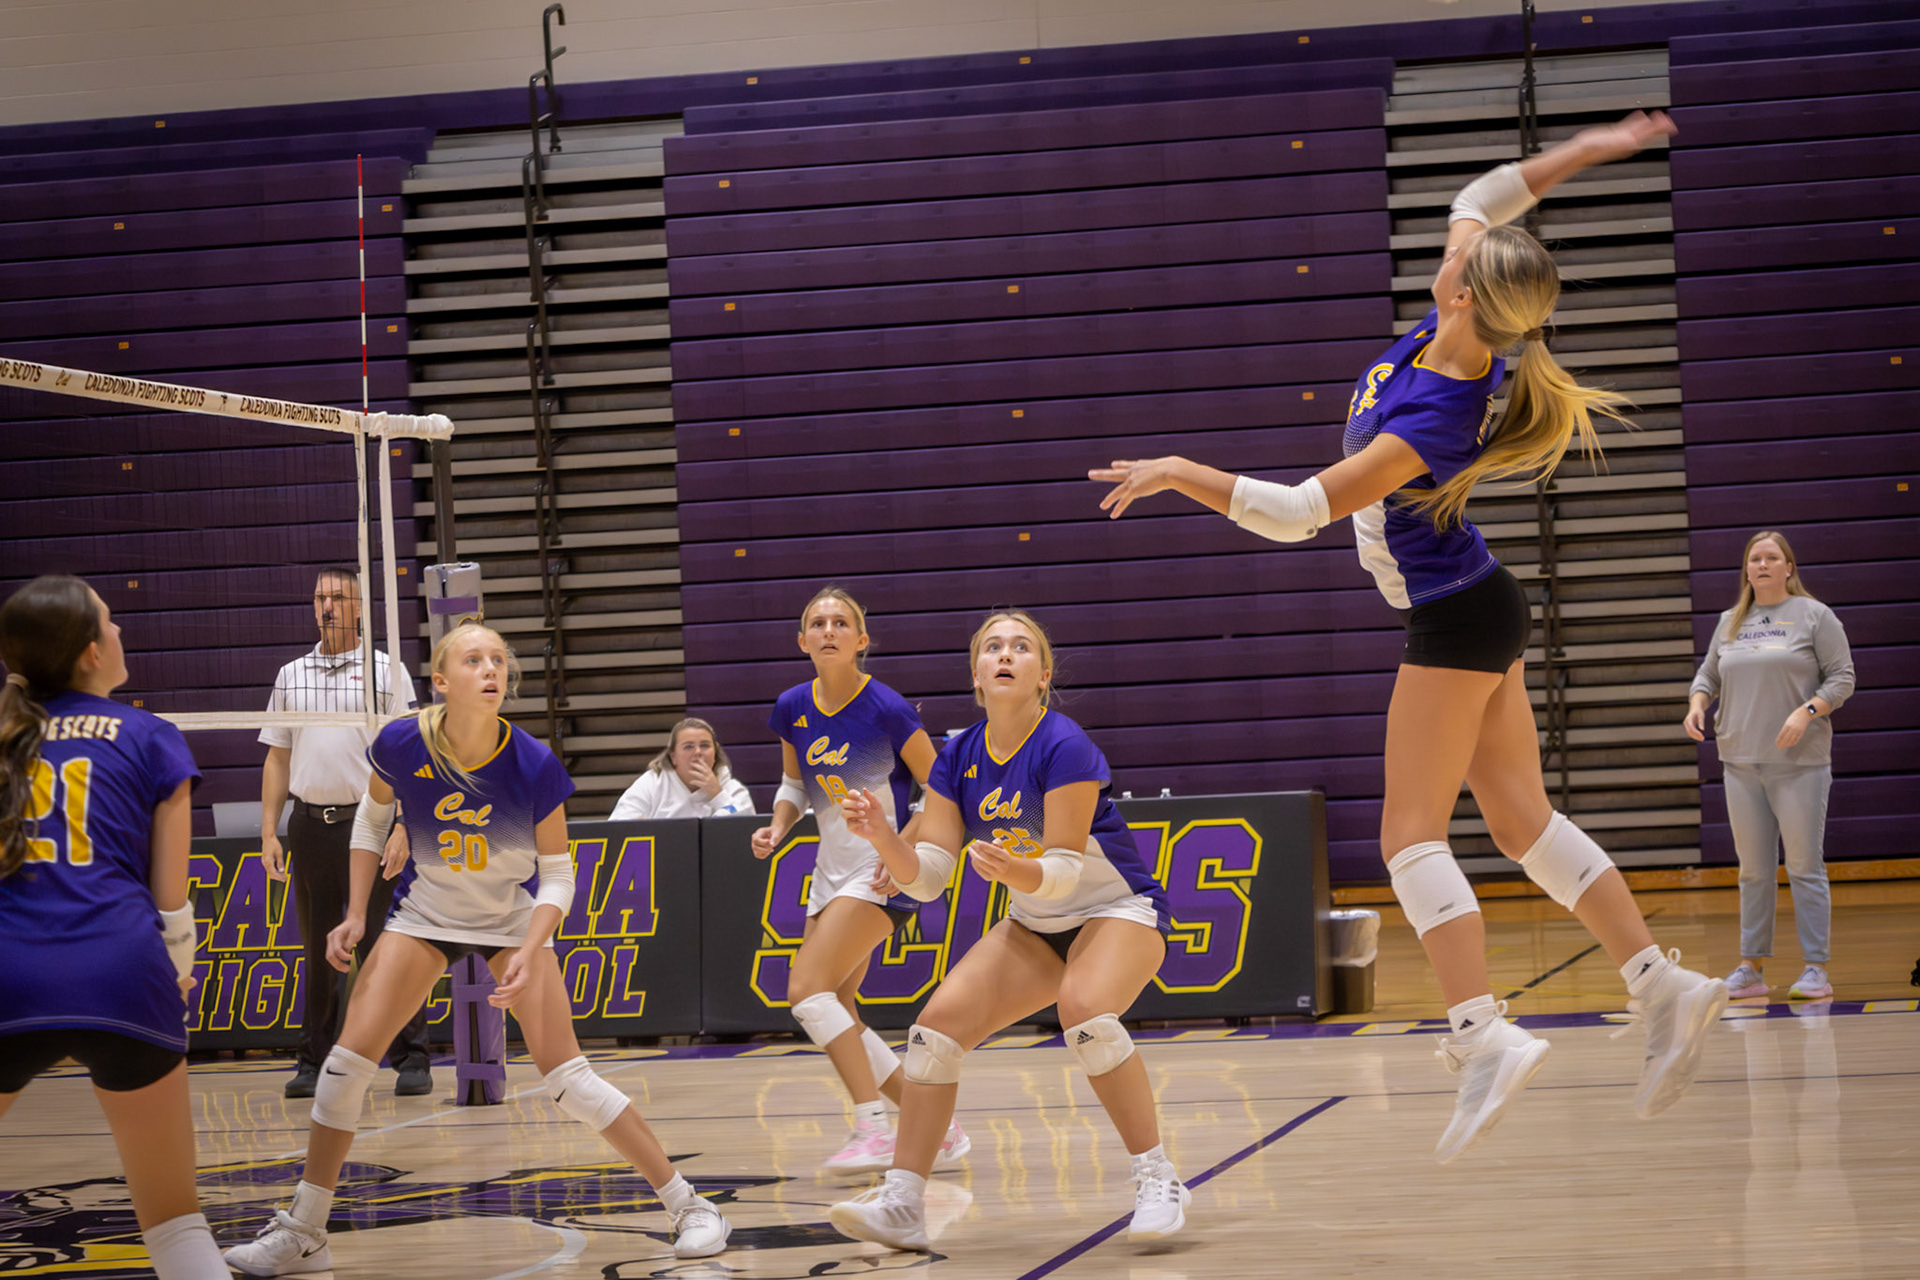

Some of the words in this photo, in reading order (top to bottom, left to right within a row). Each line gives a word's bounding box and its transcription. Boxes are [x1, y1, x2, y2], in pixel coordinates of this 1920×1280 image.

[10, 361, 43, 383] SCOTS
[84, 373, 136, 397] CALEDONIA
[135, 382, 179, 404] FIGHTING
[177, 388, 206, 407] SCOTS
[240, 397, 282, 417] CALEDONIA
[282, 404, 318, 422] FIGHTING
[319, 408, 341, 425] SCOTS
[1736, 630, 1786, 641] CALEDONIA
[59, 715, 122, 742] SCOTS
[806, 736, 850, 766] Cal
[434, 791, 493, 827] Cal
[979, 786, 1023, 821] Cal
[437, 829, 489, 873] 20
